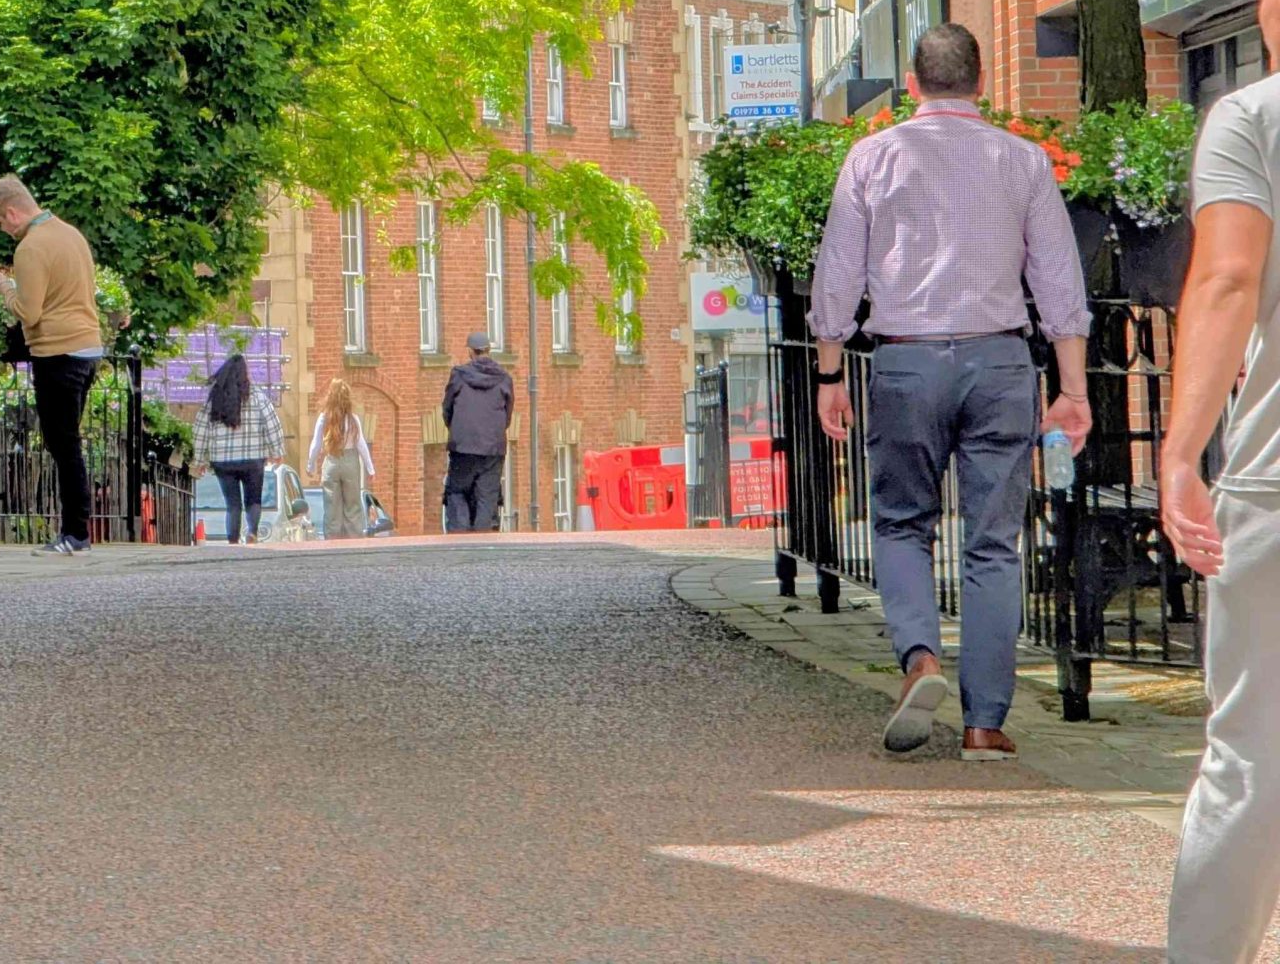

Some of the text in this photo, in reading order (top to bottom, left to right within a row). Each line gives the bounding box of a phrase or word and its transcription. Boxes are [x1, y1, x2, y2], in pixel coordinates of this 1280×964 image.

[747, 53, 799, 67] bartletts
[740, 79, 792, 89] The Accident
[731, 92, 758, 101] Claims
[710, 295, 765, 308] GLOW
